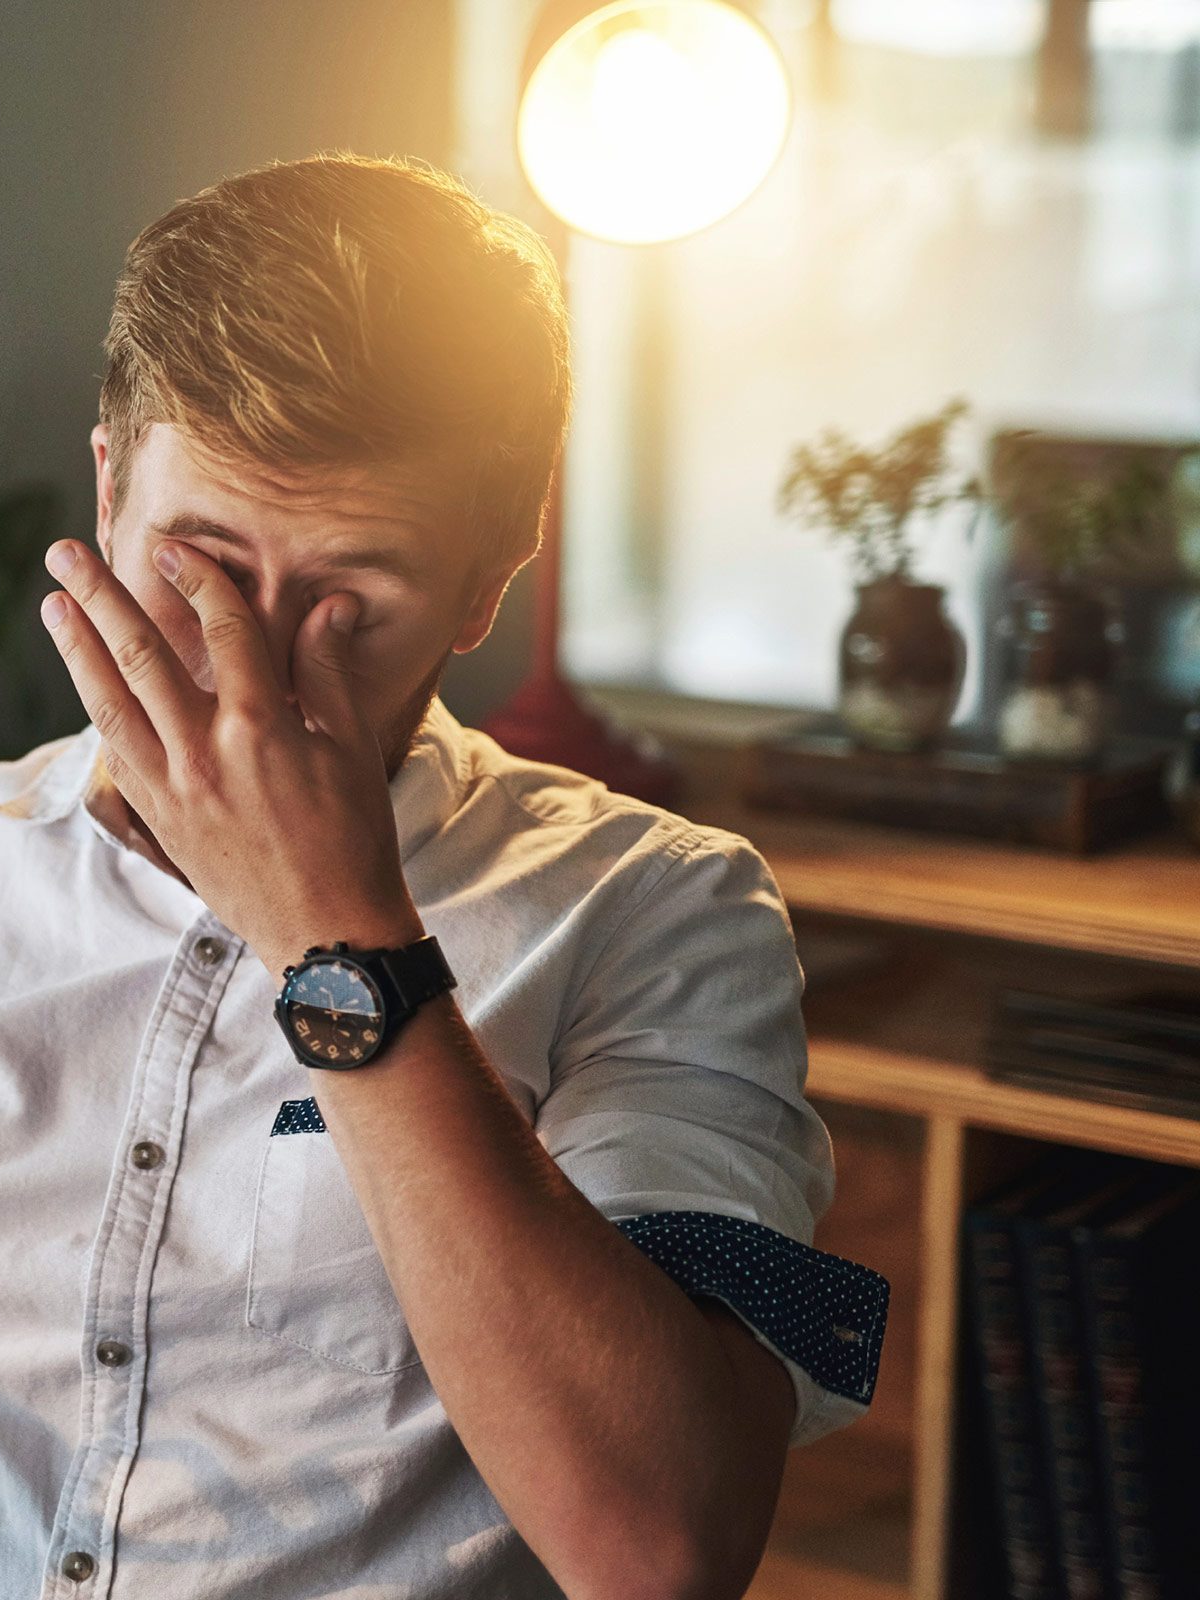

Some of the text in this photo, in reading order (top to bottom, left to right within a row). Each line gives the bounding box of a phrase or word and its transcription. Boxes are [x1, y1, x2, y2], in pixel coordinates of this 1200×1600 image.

[296, 1019, 310, 1038] 12
[310, 1040, 321, 1051] 11
[328, 1045, 339, 1059] 10
